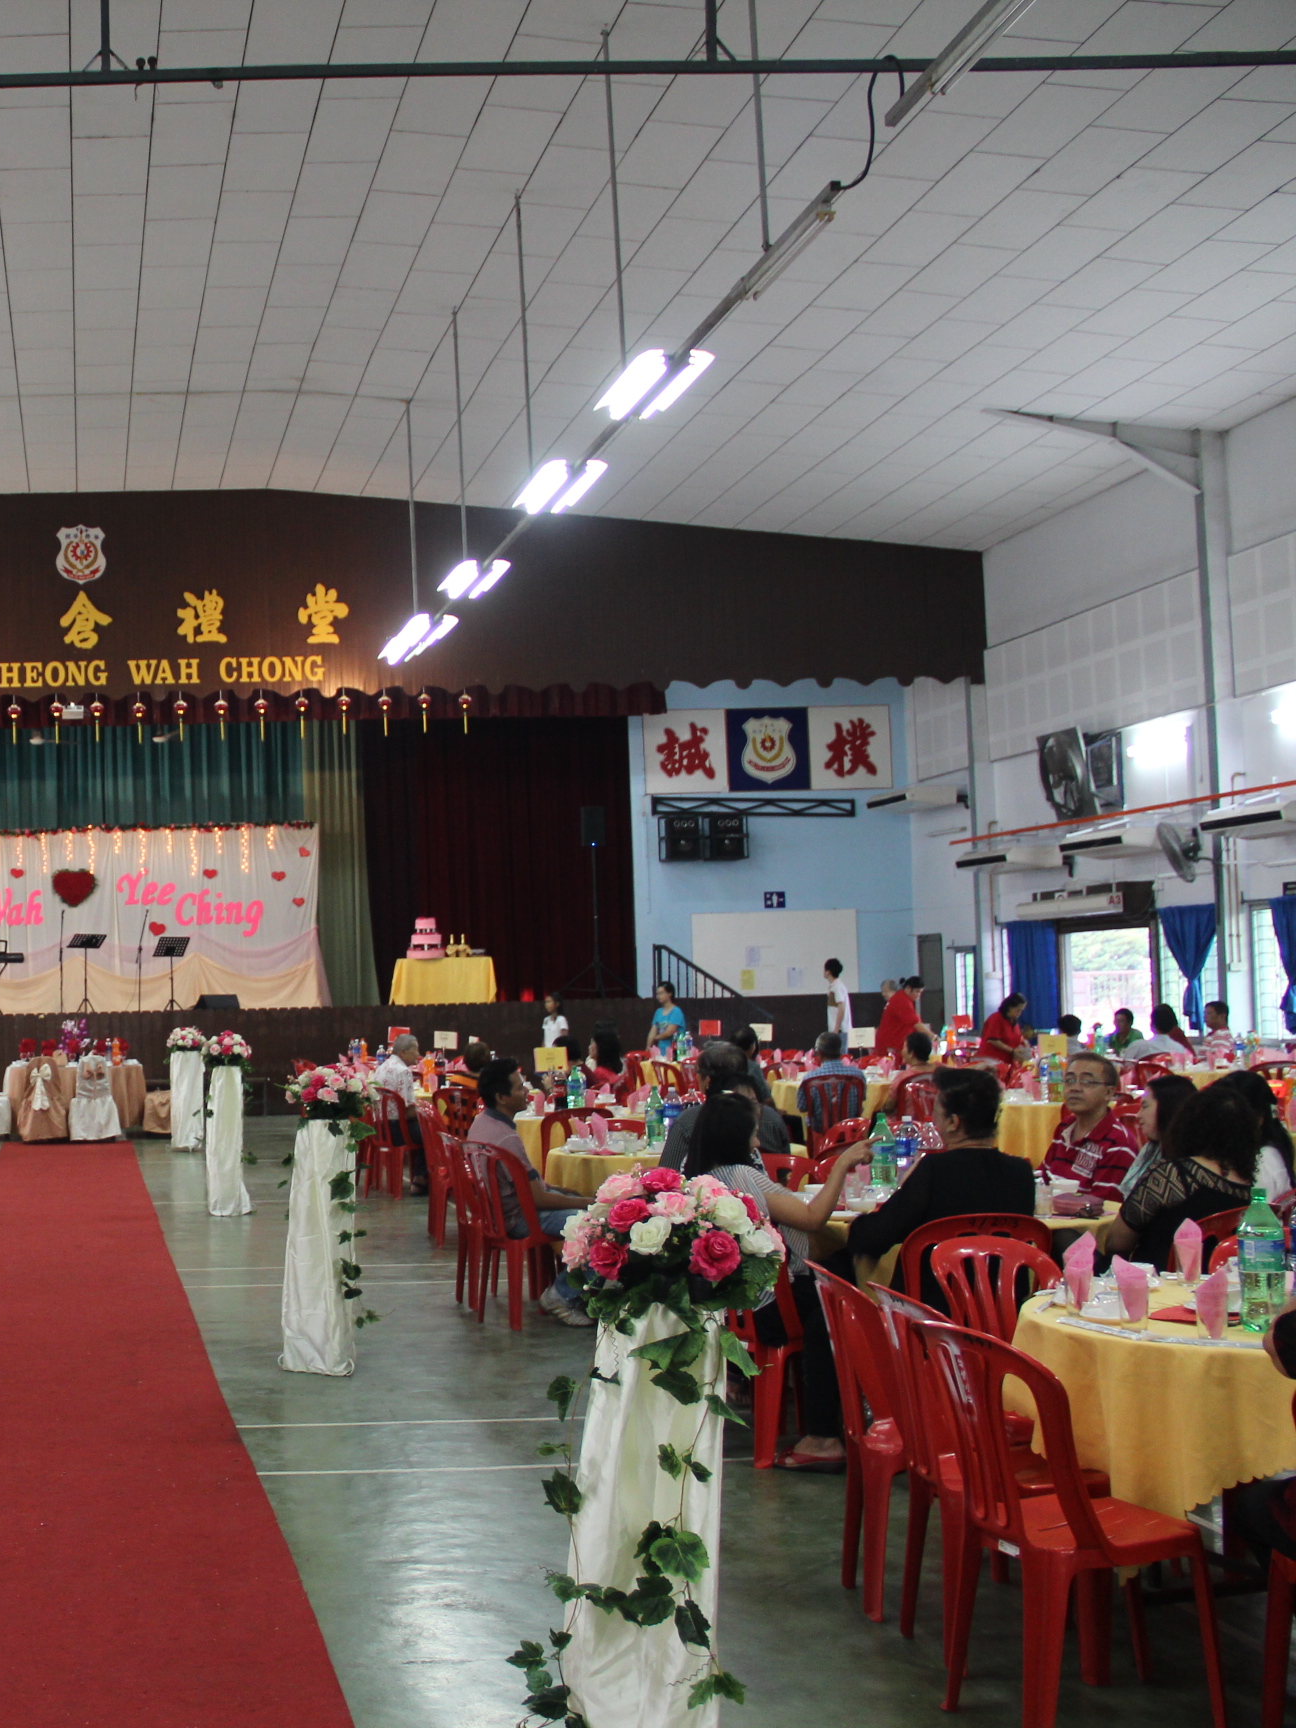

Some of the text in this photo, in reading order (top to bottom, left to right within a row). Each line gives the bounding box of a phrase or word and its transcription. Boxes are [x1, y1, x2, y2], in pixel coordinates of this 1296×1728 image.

[128, 658, 201, 686] WAH
[219, 655, 326, 684] CHONG
[656, 721, 716, 780] 誠
[116, 867, 264, 937] Yee Ching
